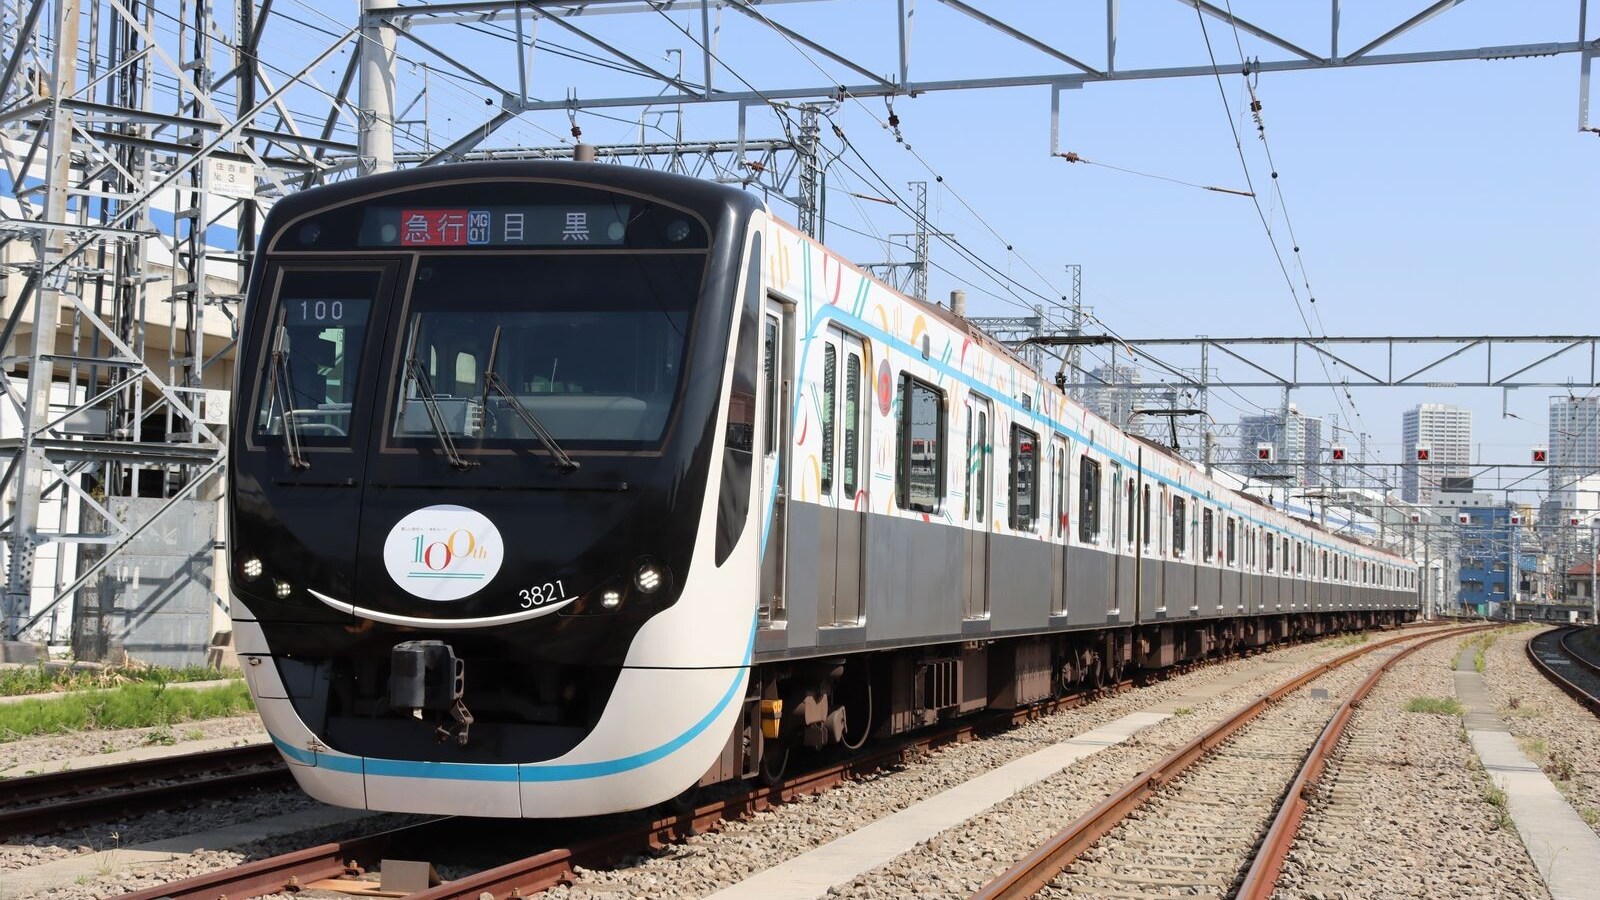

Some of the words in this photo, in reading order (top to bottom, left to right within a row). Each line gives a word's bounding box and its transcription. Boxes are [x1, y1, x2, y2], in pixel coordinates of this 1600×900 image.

[228, 174, 235, 182] 3
[405, 213, 463, 243] 急行
[470, 213, 488, 226] MG
[504, 213, 589, 242] 目黒
[470, 227, 486, 241] 01
[300, 300, 343, 320] 100
[410, 528, 487, 571] 100th
[518, 581, 566, 609] 3821
